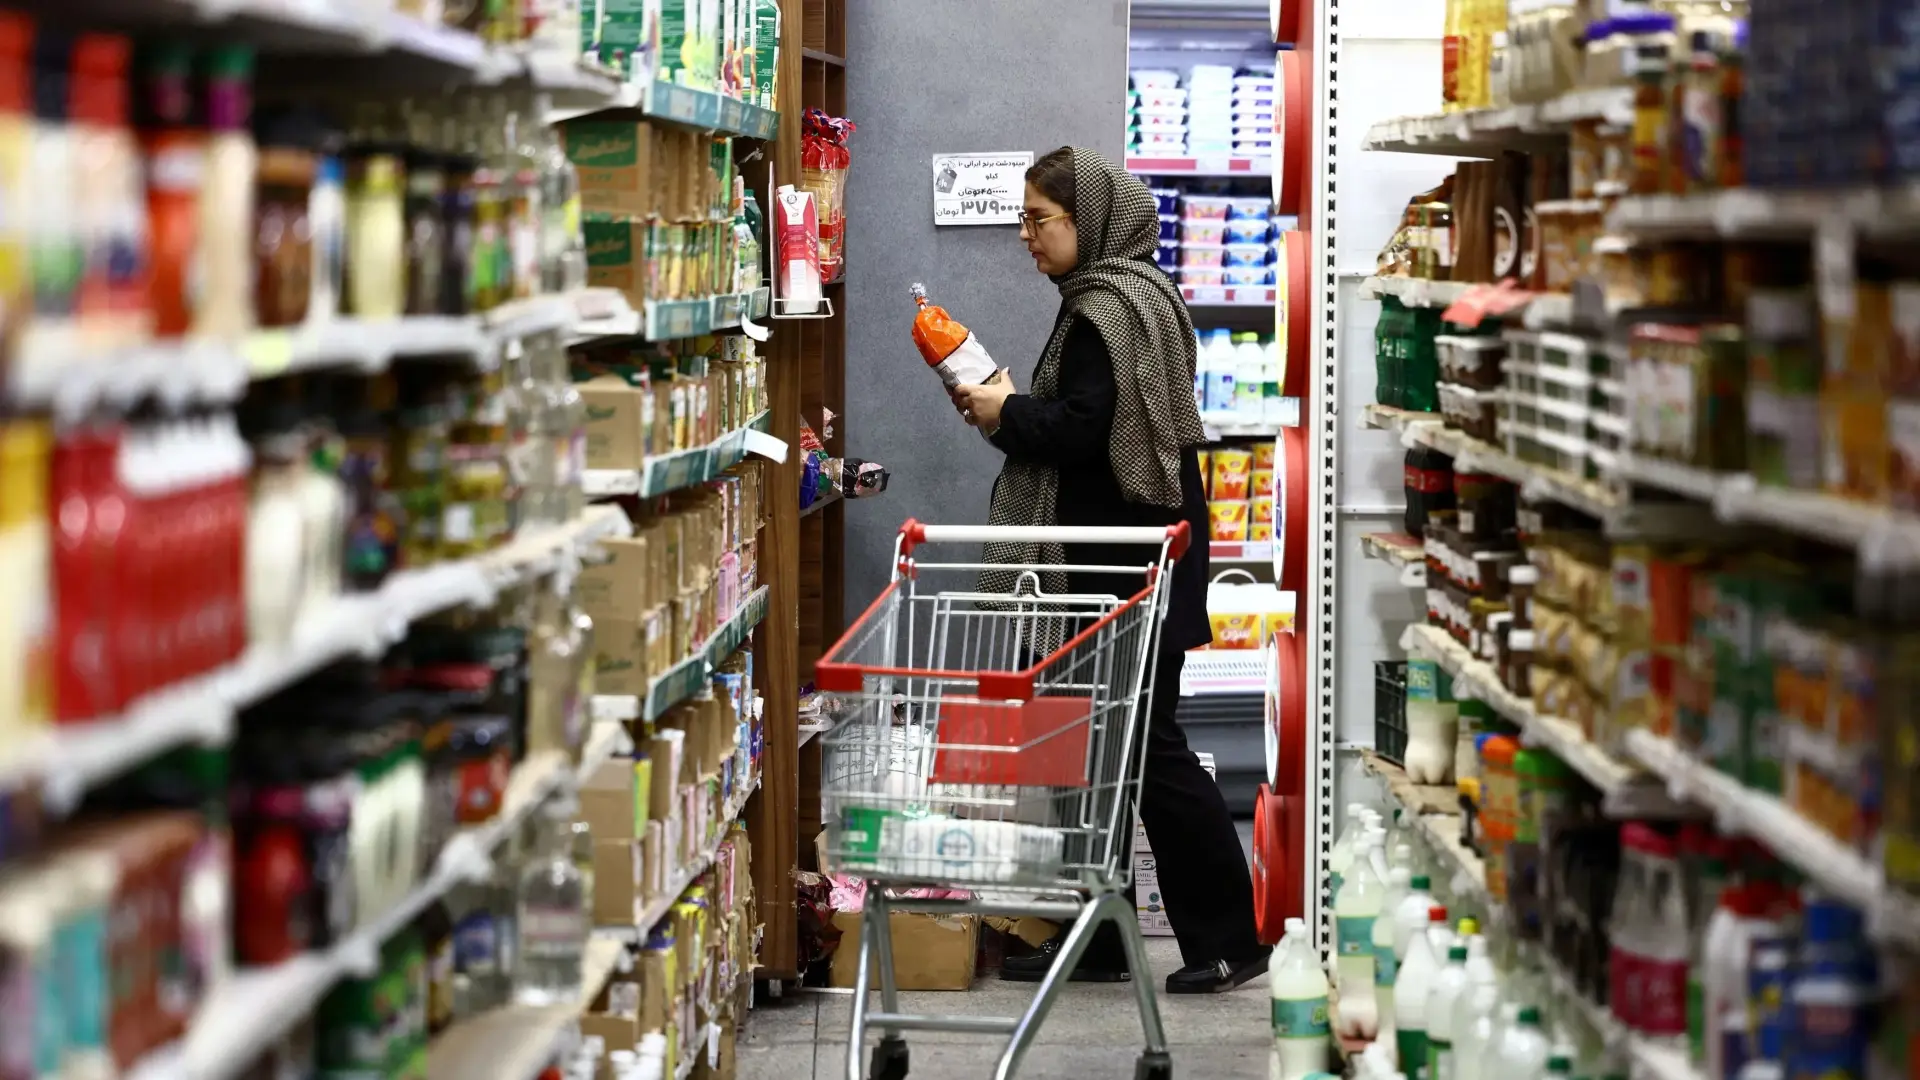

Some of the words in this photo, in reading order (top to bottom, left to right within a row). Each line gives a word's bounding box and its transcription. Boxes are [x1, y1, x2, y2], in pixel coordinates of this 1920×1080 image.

[965, 160, 981, 168] ایرانی
[982, 160, 994, 168] برنج
[936, 208, 959, 216] تومان
